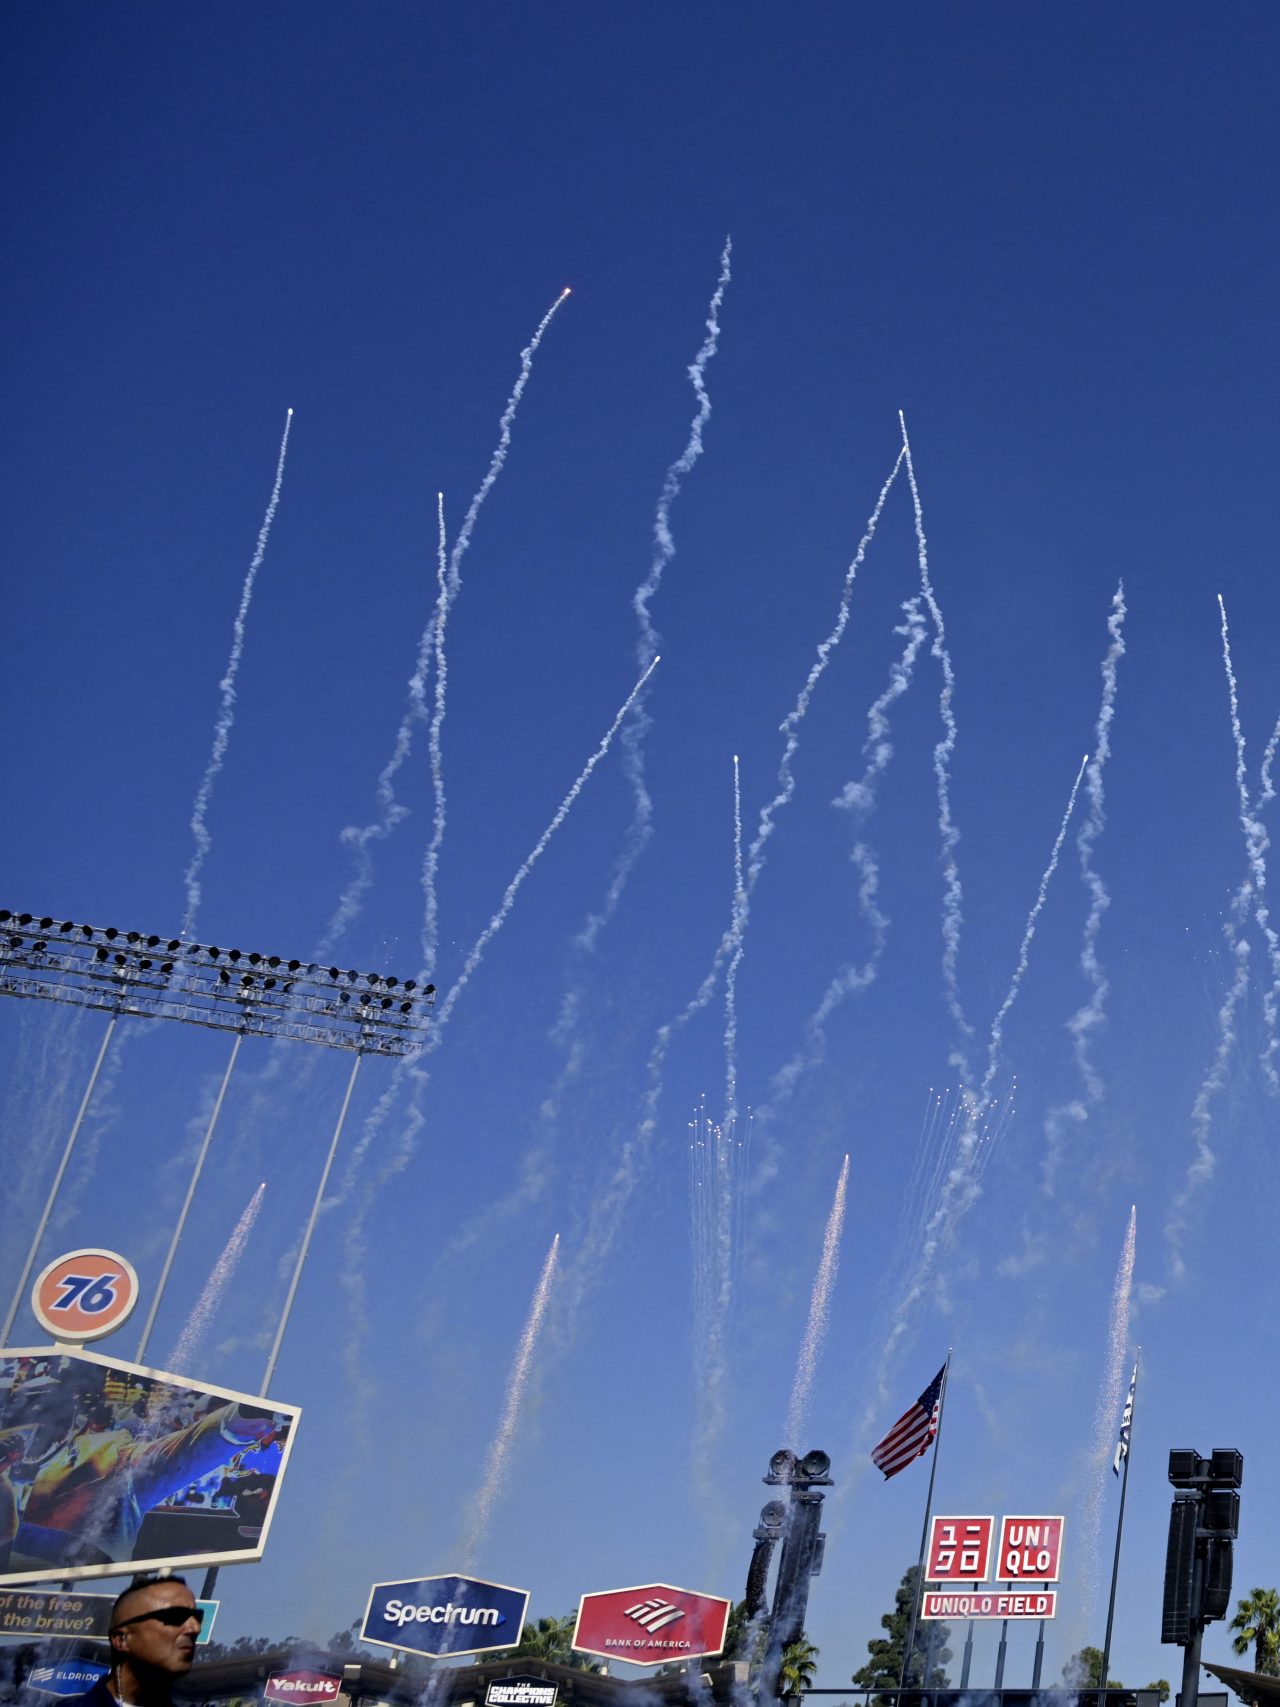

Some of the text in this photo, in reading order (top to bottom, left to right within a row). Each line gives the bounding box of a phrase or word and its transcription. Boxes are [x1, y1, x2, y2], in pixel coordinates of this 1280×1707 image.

[48, 1273, 121, 1315] 76
[939, 1526, 981, 1546] ユニ
[1009, 1526, 1050, 1546] UNI
[1006, 1550, 1051, 1575] QLO
[17, 1596, 44, 1610] the
[49, 1597, 83, 1612] free
[930, 1597, 1047, 1617] UNIQLO FIELD
[3, 1612, 94, 1630] the brave?
[383, 1600, 499, 1627] Spectrum
[647, 1640, 691, 1648] AMERICA
[56, 1671, 100, 1682] ELDRIDG
[272, 1679, 336, 1693] Yakult
[490, 1686, 556, 1695] CHAMPIONS
[488, 1694, 554, 1704] COLLECTIVE
